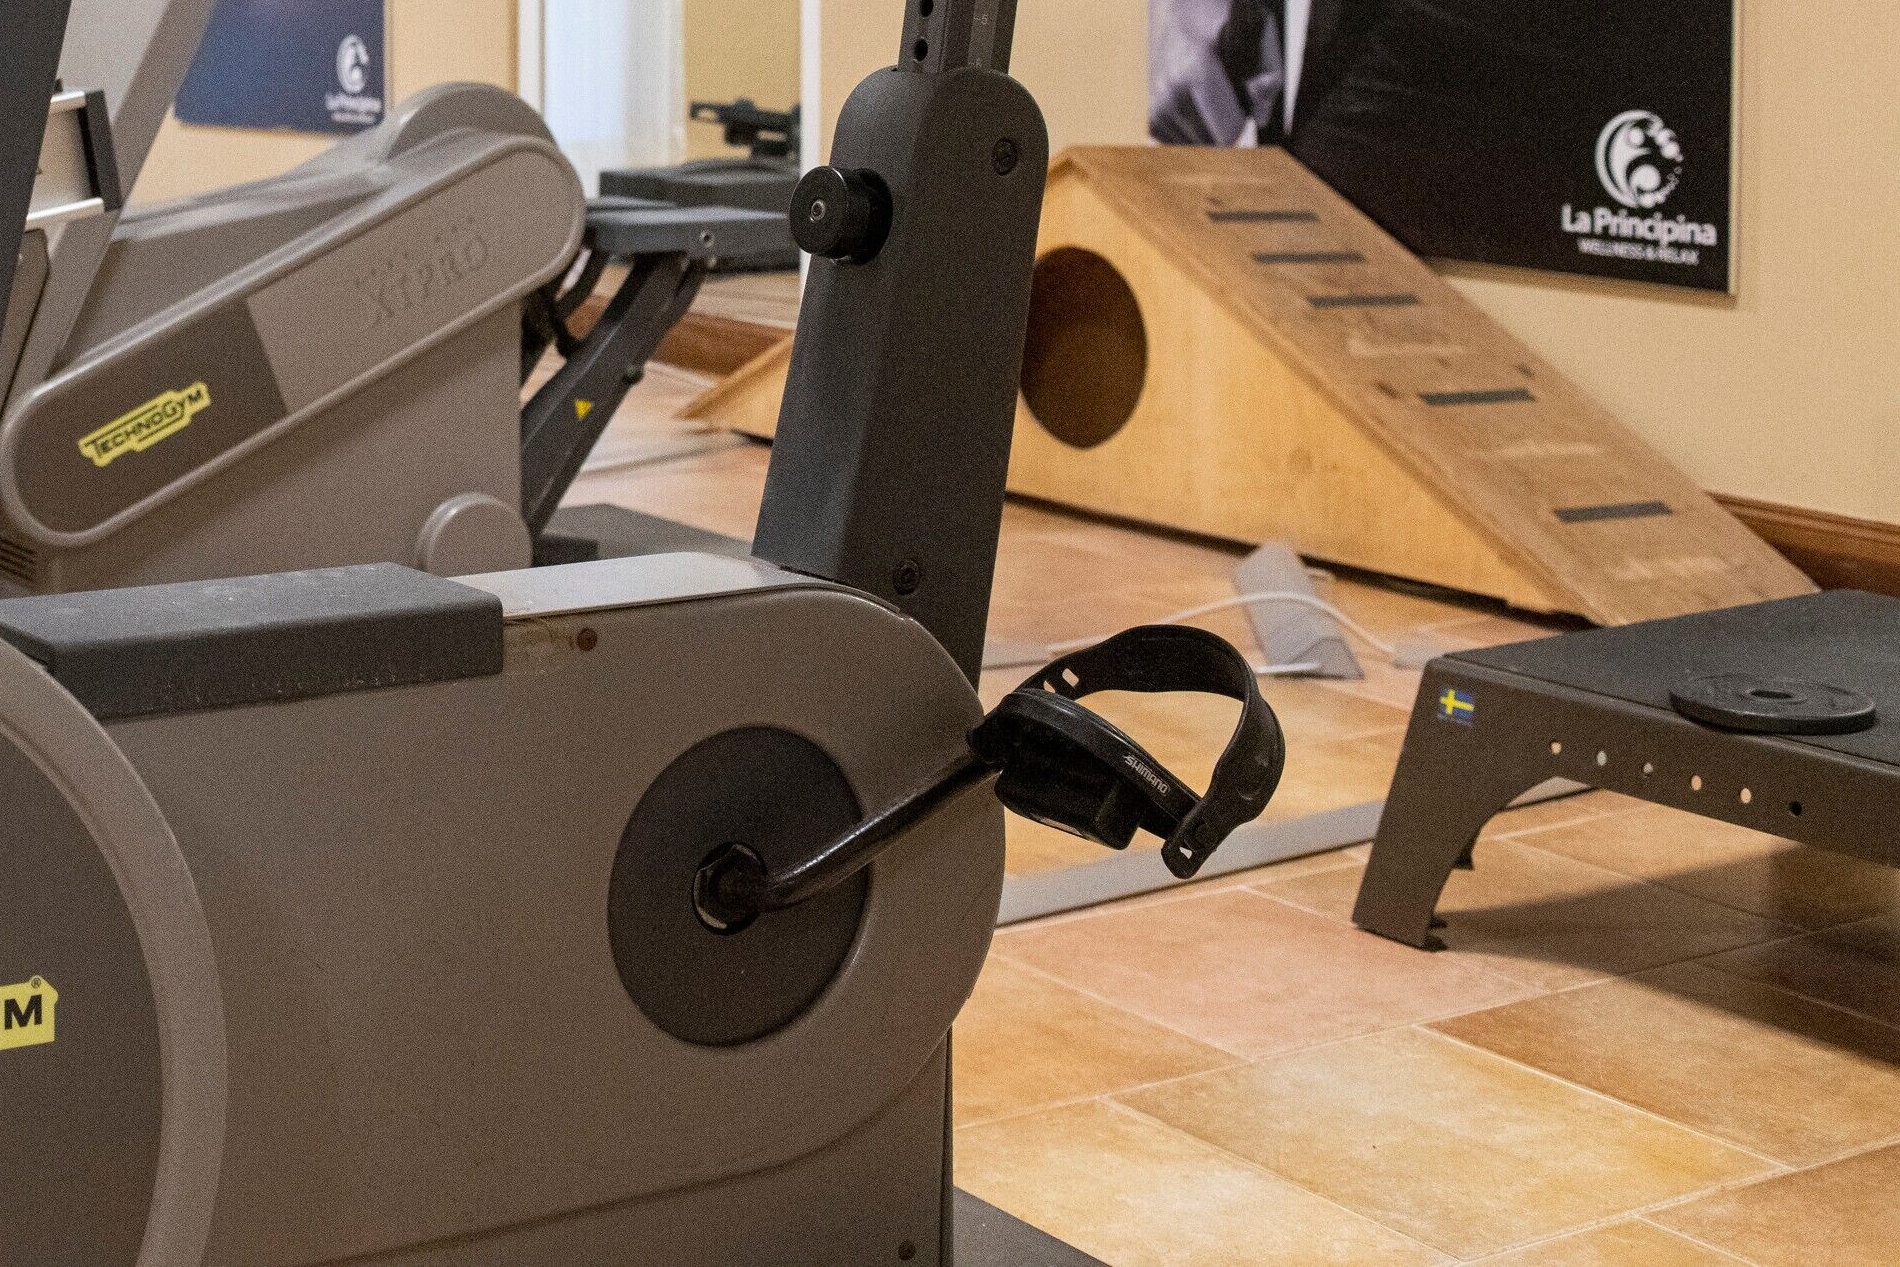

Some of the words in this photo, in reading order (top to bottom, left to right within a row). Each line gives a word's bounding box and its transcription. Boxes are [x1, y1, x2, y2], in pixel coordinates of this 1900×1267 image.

[1561, 203, 1592, 234] La
[1593, 206, 1718, 248] Principina
[83, 389, 204, 459] TECHNOGYM
[1122, 753, 1169, 794] SHIMANO
